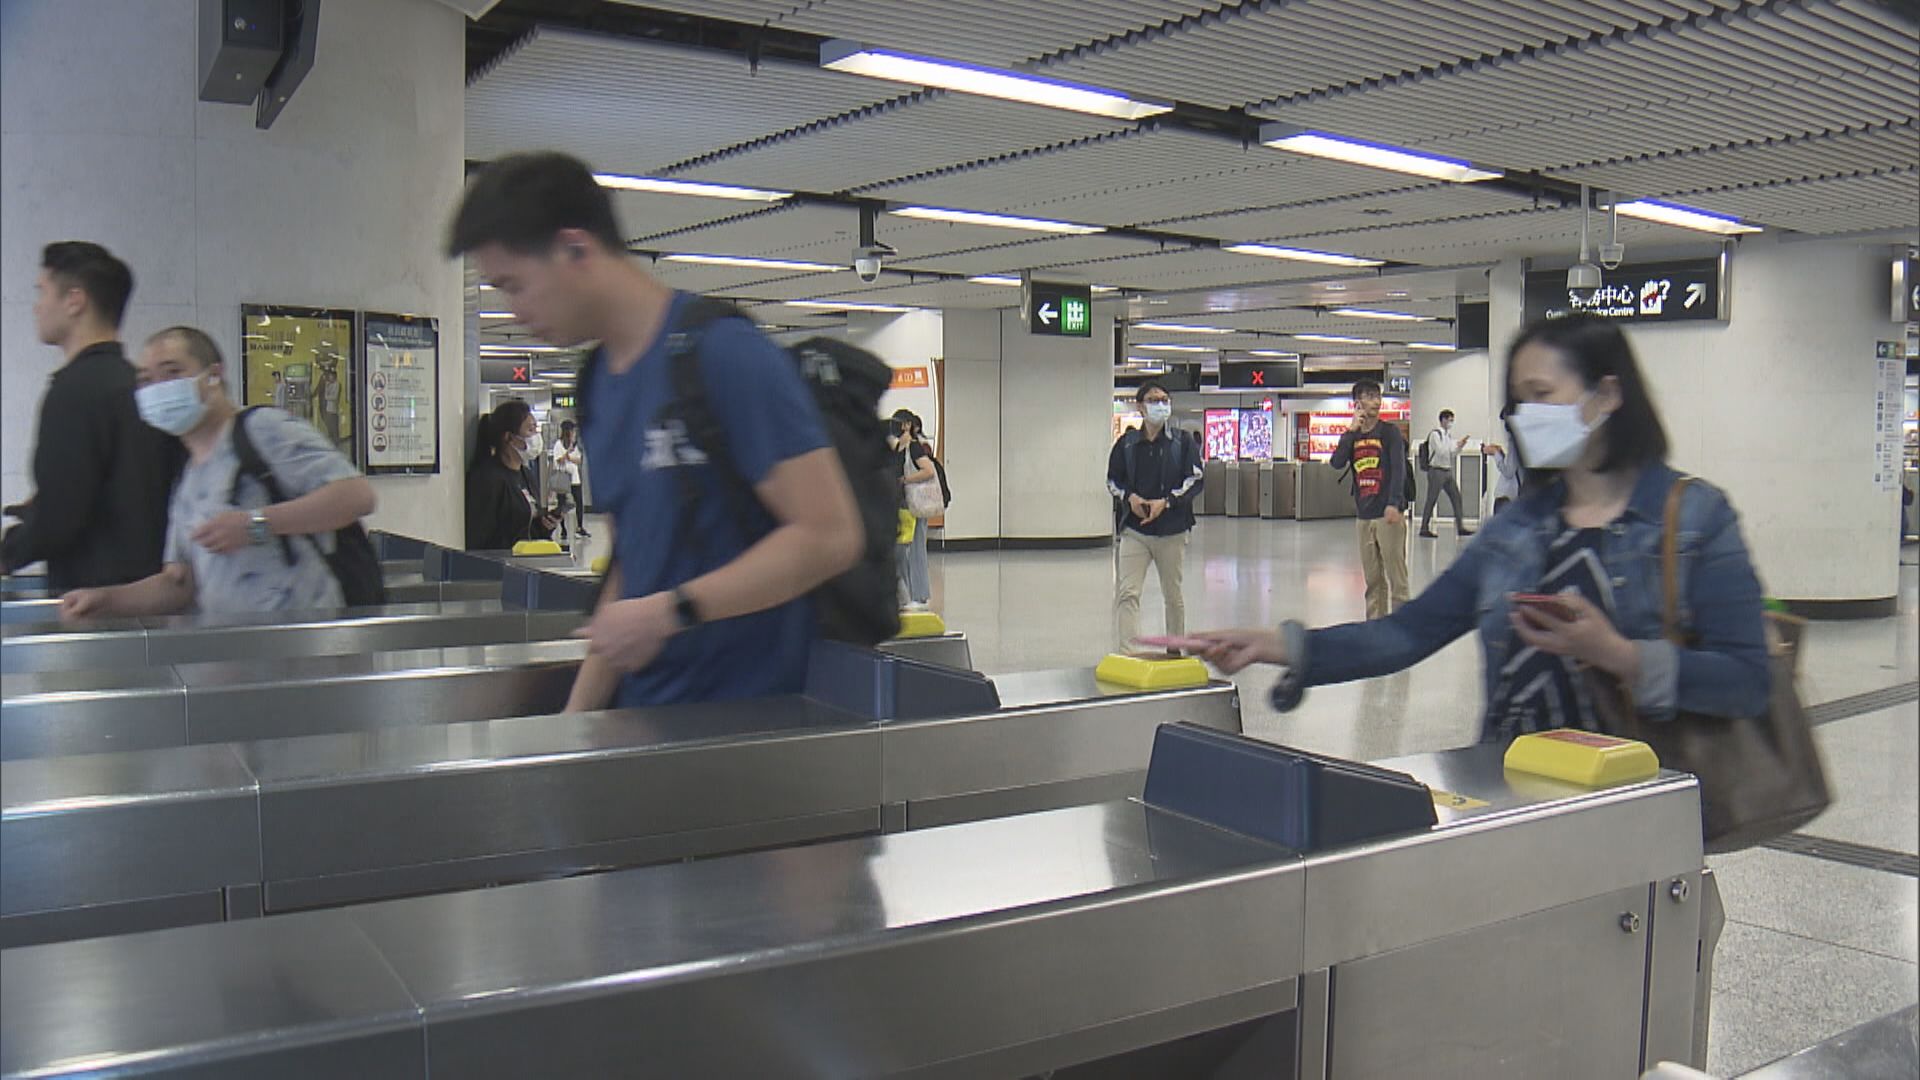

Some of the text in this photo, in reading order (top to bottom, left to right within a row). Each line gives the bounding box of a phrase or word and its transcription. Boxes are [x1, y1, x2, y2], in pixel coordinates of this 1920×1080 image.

[1067, 301, 1084, 321] 出
[1609, 307, 1635, 316] Centre
[1067, 321, 1084, 330] EXIT
